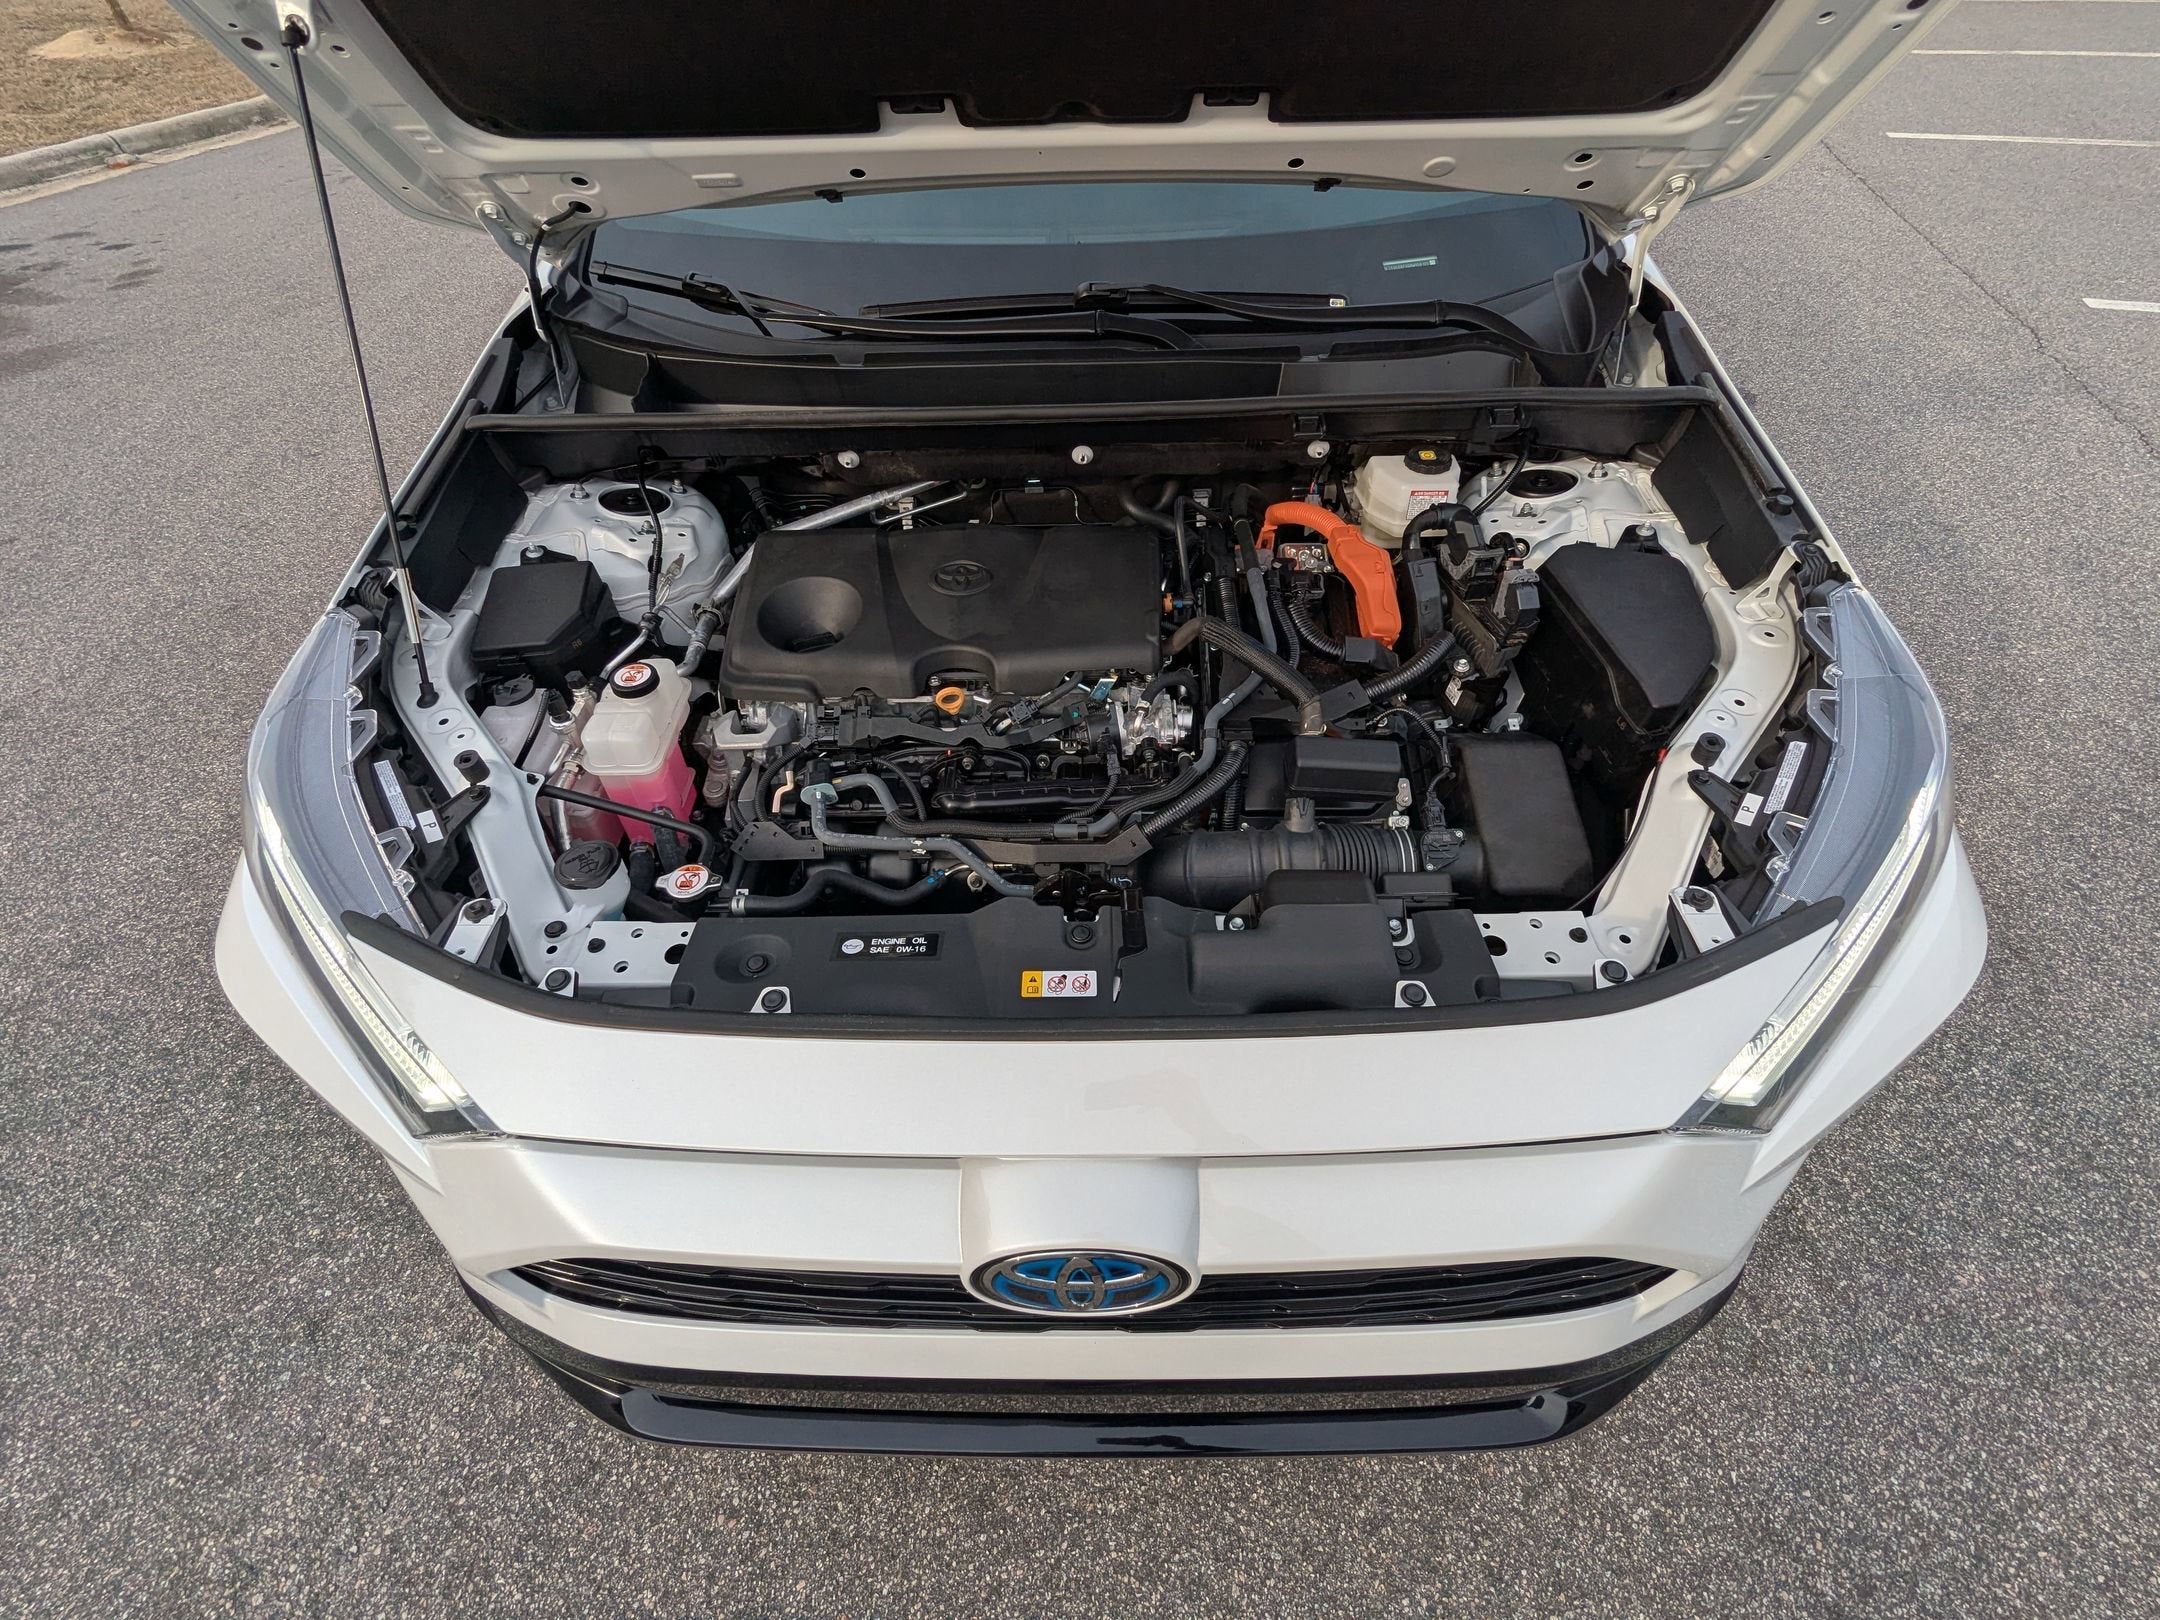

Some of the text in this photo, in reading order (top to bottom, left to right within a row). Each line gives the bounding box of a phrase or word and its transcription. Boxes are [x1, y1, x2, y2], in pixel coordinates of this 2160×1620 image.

[1741, 805, 1754, 813] P
[871, 937, 906, 945] ENGINE
[869, 945, 926, 954] SAE 0W-16
